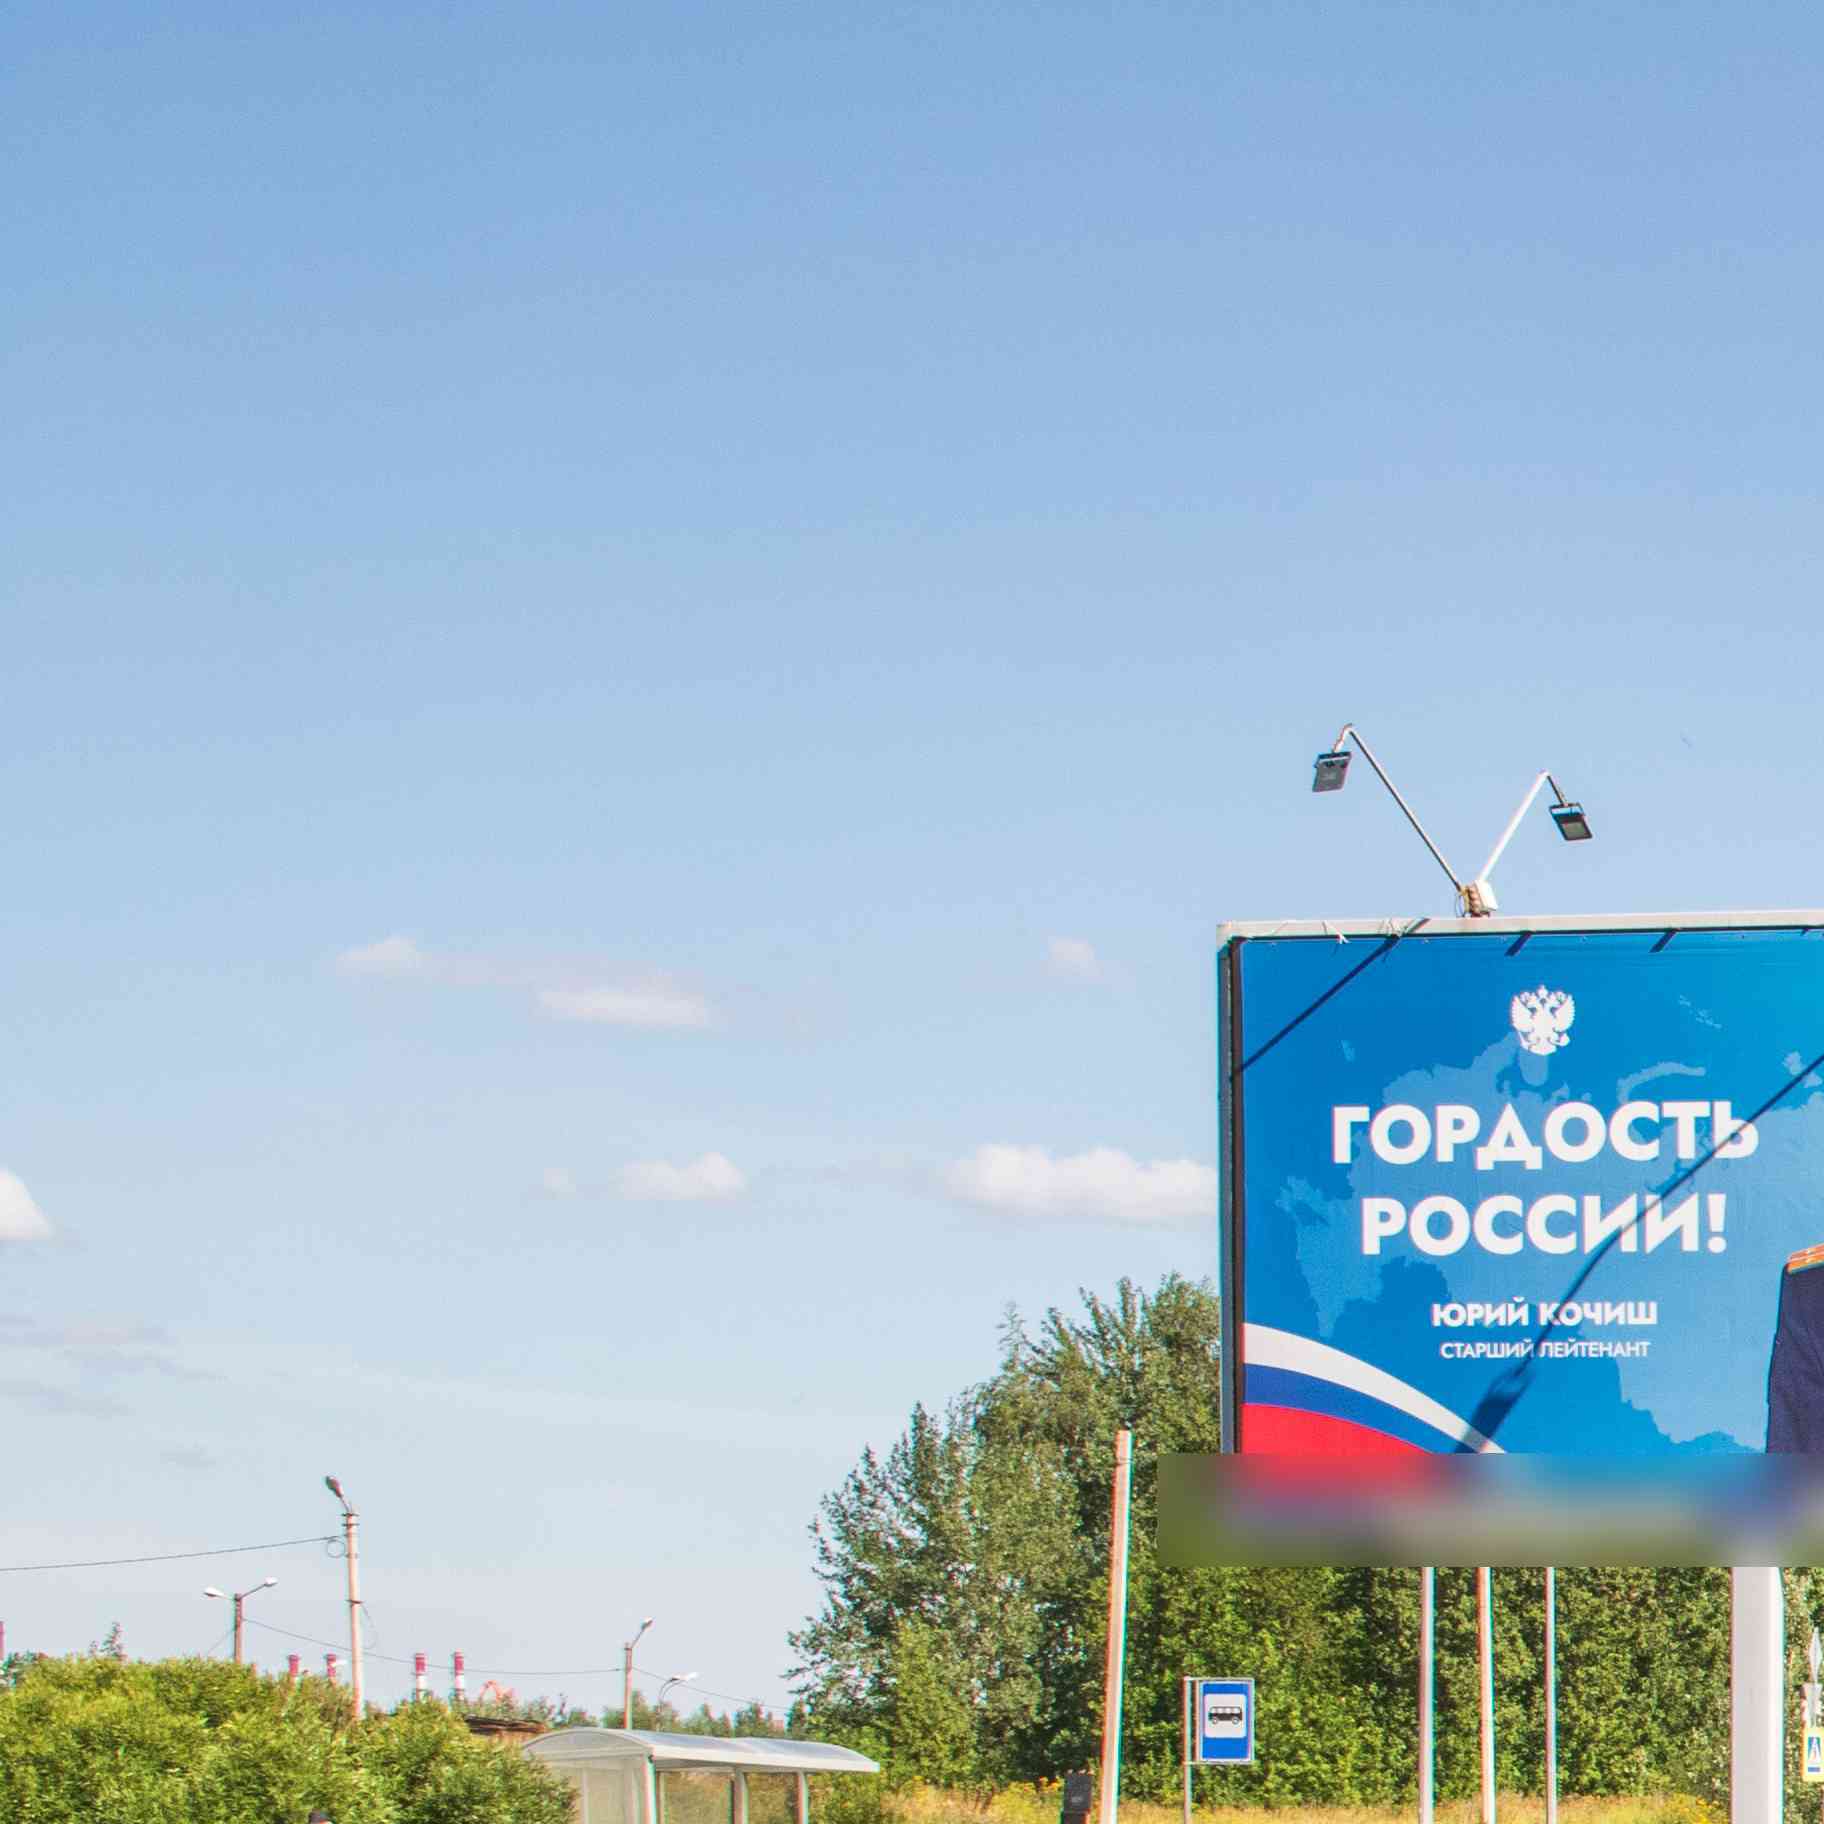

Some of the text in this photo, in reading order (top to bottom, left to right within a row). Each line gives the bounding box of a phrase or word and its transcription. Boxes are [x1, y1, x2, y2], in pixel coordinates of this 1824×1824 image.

[1332, 1100, 1760, 1170] ГОРДОСТЬ
[1361, 1193, 1728, 1257] РОССИИ!
[1432, 1296, 1658, 1327] ЮРИЙ КОЧИШ
[1440, 1337, 1651, 1359] СТАРШИЙ ЛЕЙТЕНАНТ
